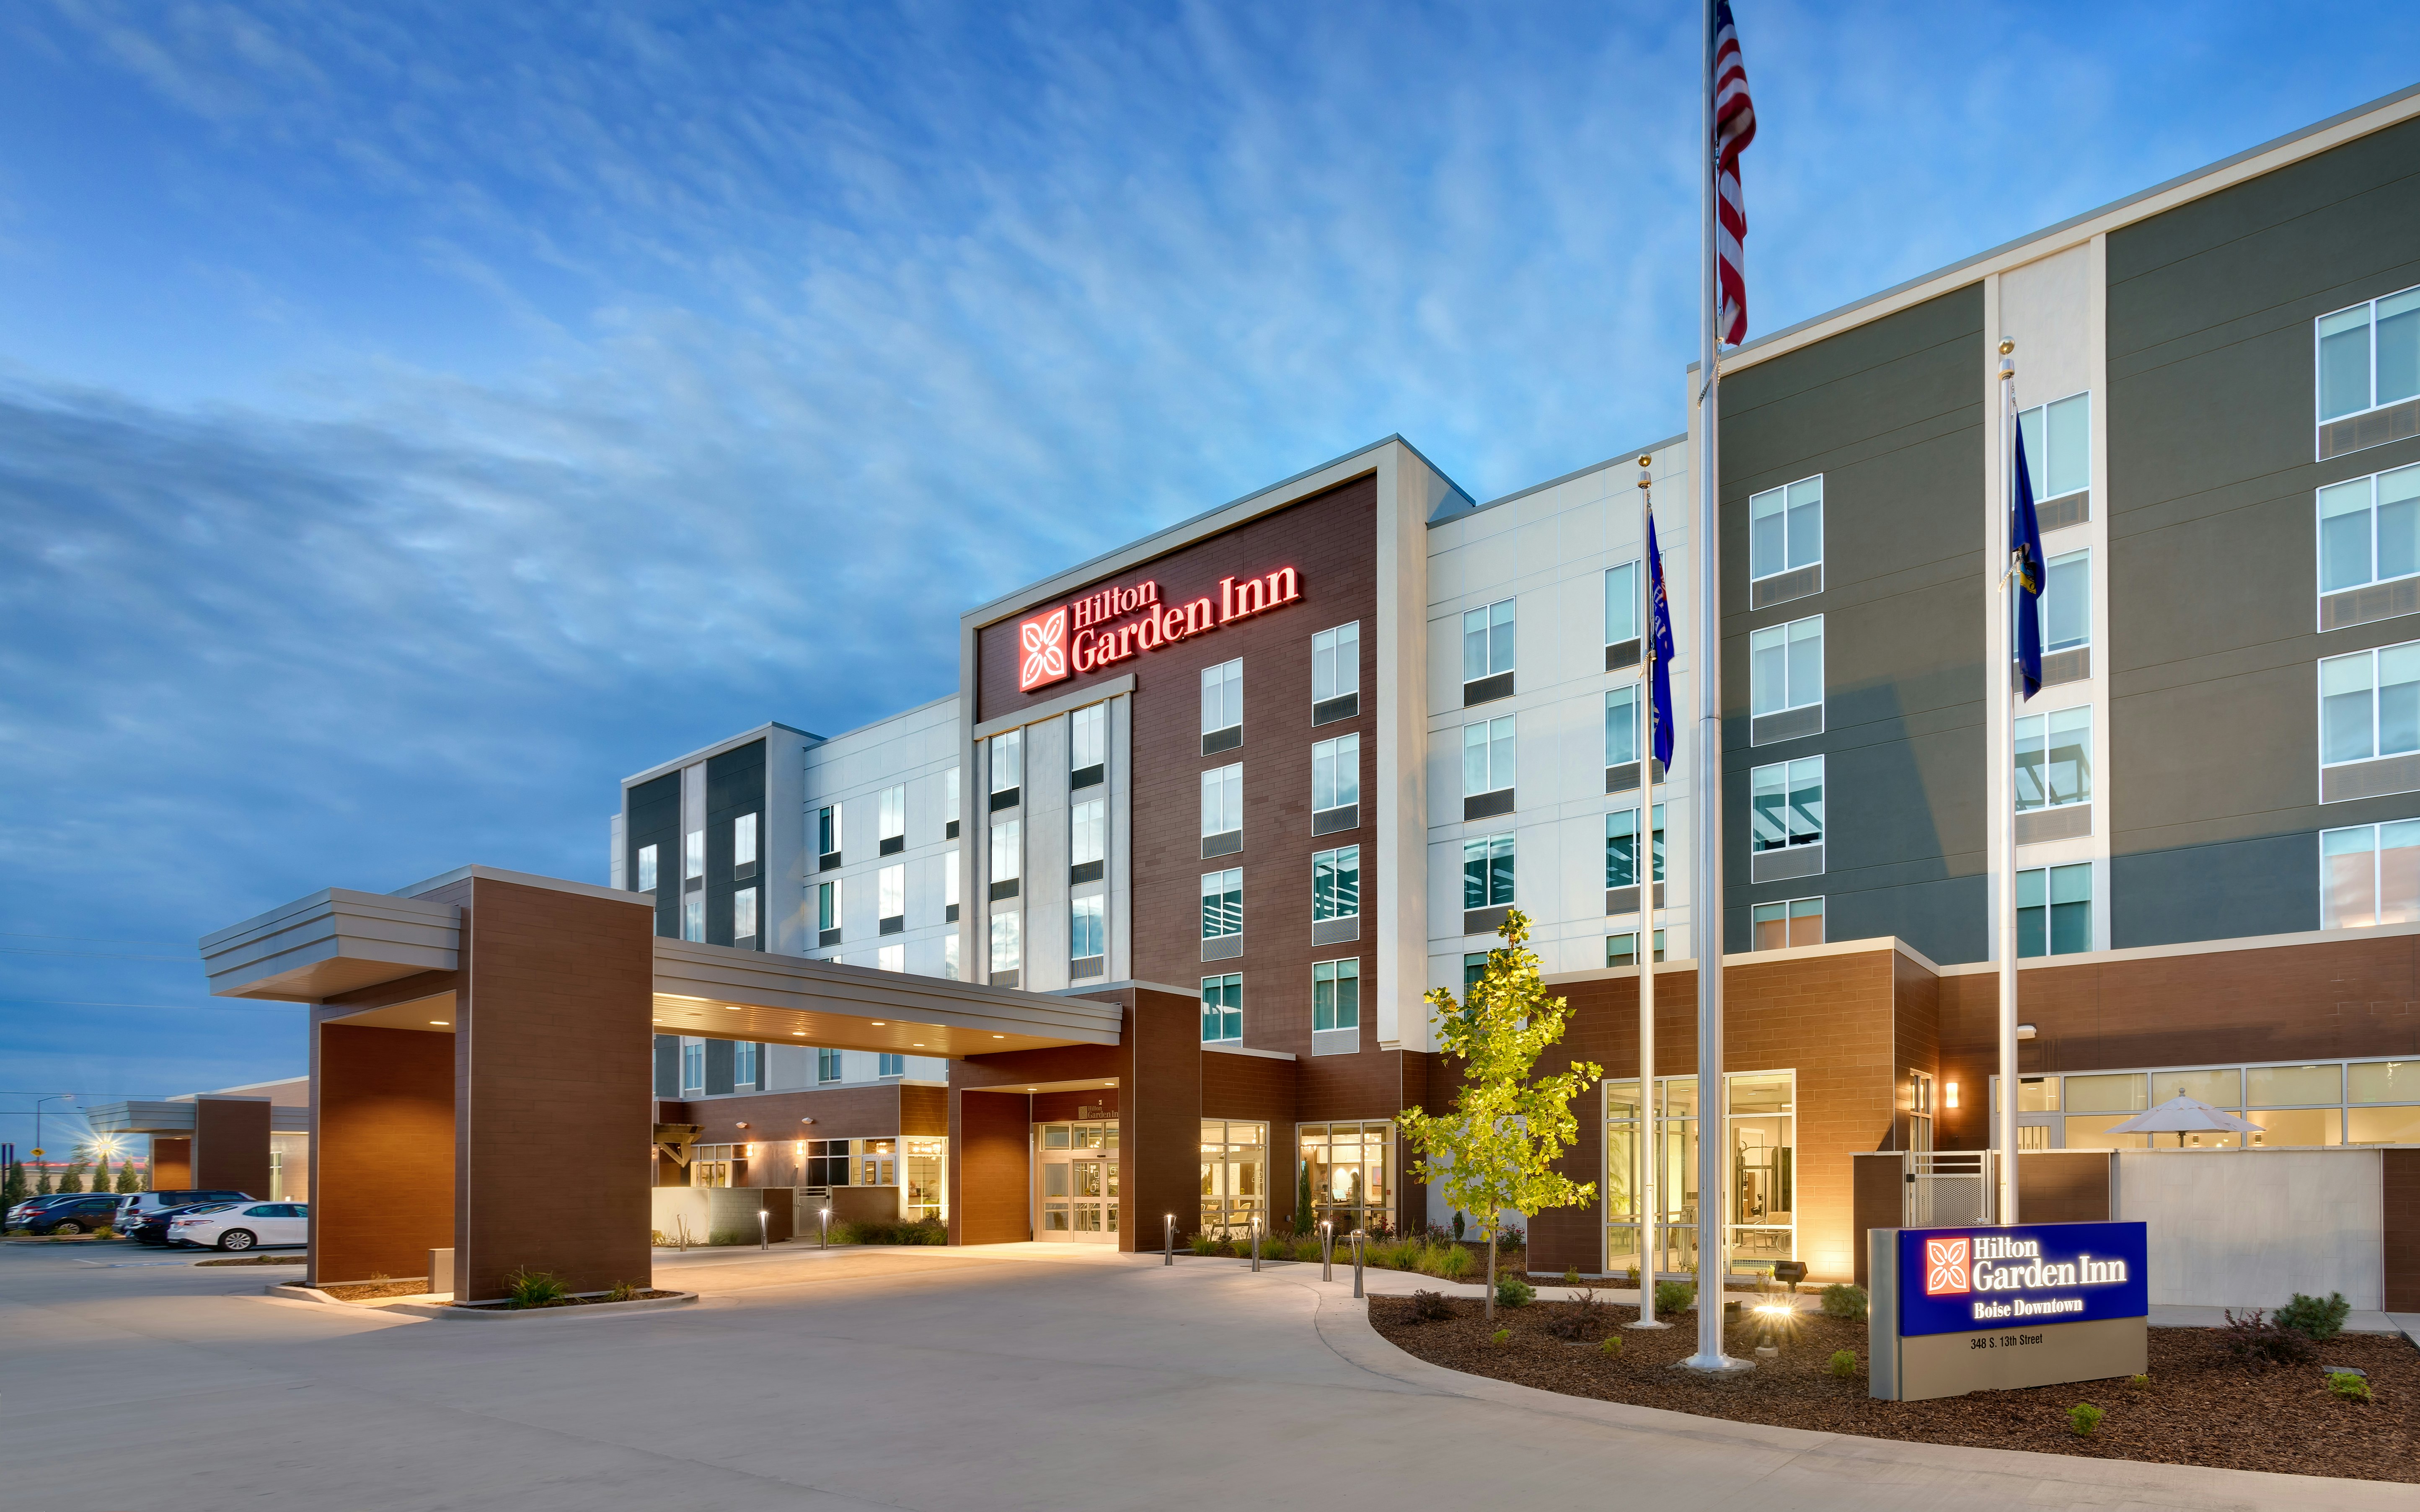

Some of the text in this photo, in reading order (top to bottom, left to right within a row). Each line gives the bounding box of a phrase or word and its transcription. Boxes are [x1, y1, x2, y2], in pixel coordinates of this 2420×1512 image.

[1073, 580, 1158, 630] Hilton
[1072, 567, 1299, 672] Garden Inn
[1973, 1237, 2039, 1259] Hilton
[1973, 1256, 2127, 1291] Garden Inn
[1974, 1298, 2083, 1319] Boise Downtown
[1971, 1333, 2043, 1349] 348 S. 13th Street
